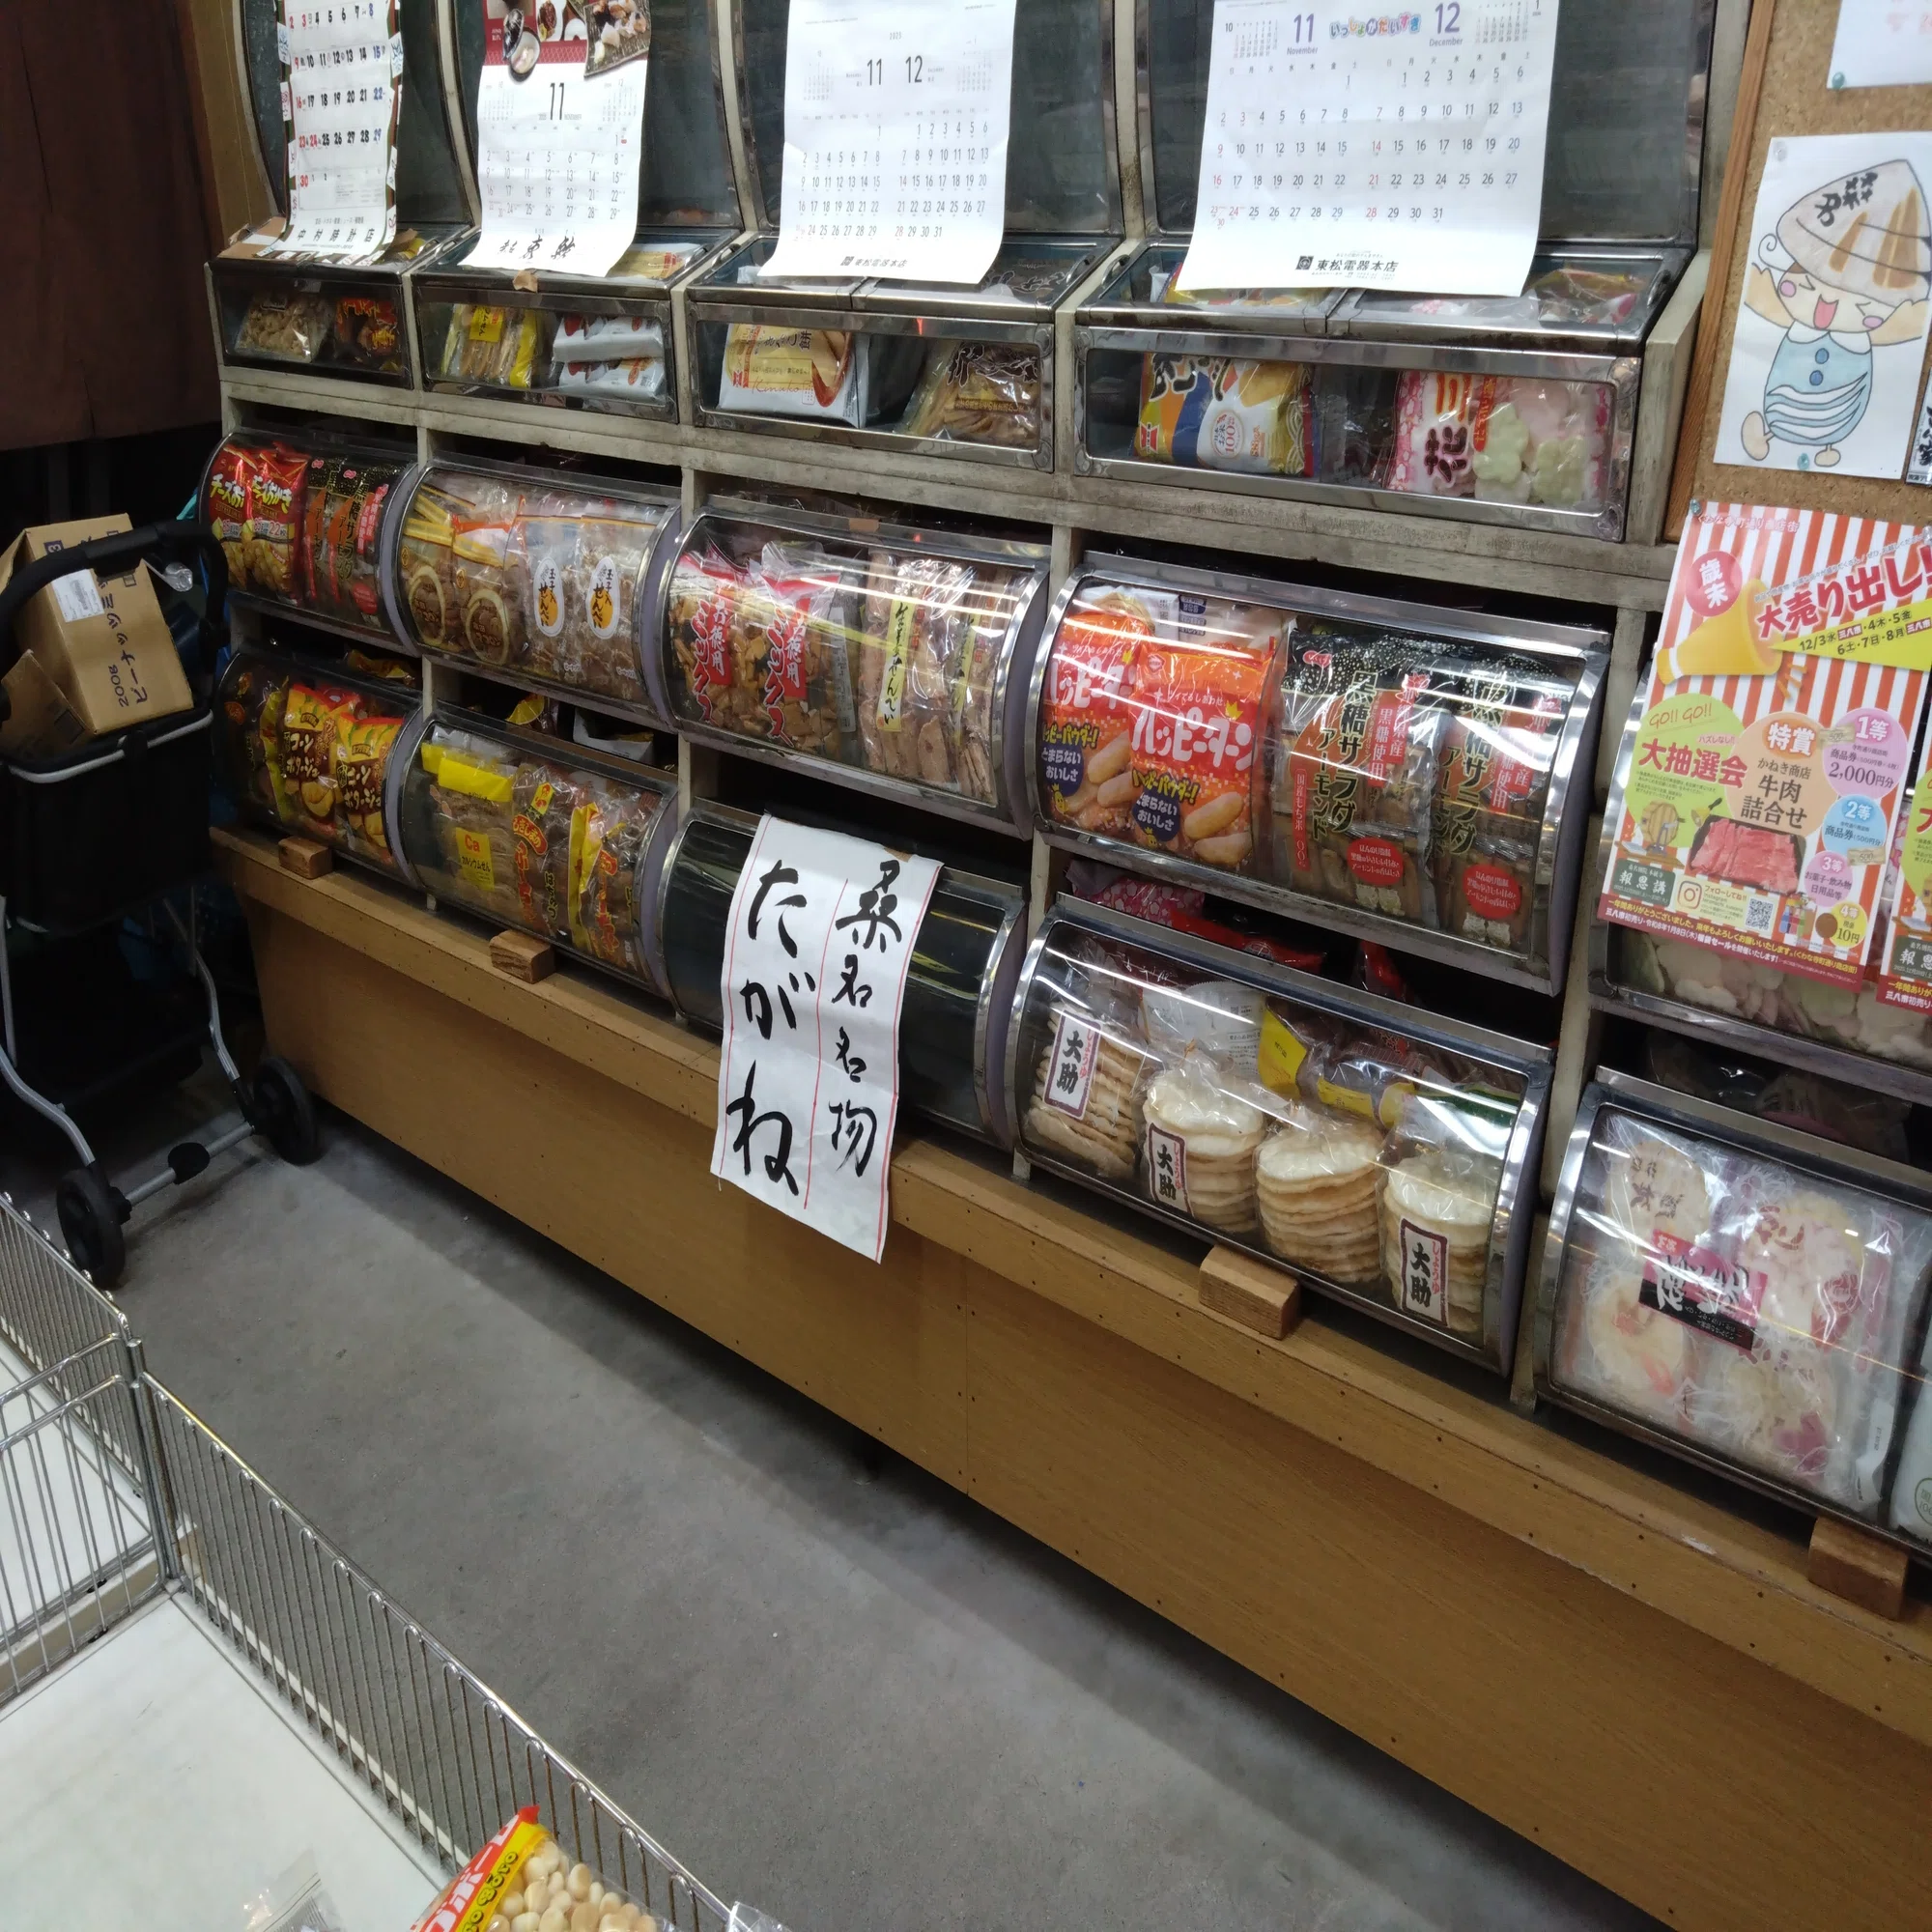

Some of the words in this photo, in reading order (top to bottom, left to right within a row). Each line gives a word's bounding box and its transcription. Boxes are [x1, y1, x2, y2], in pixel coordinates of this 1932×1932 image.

[327, 11, 333, 22] 5
[341, 8, 347, 20] 6
[1435, 3, 1461, 35] 12
[1293, 14, 1315, 43] 11
[1429, 37, 1463, 48] December
[1287, 45, 1318, 56] November
[307, 55, 314, 68] 10
[346, 49, 353, 62] 13
[867, 58, 882, 86] 11
[905, 55, 923, 84] 12
[1403, 72, 1407, 82] 1
[1446, 70, 1453, 81] 3
[1493, 68, 1500, 78] 5
[321, 94, 327, 106] 18
[347, 91, 355, 103] 20
[550, 82, 565, 121] 11
[1220, 113, 1227, 123] 2
[1259, 111, 1264, 121] 4
[1299, 110, 1306, 120] 6
[1342, 108, 1349, 119] 8
[1420, 105, 1428, 116] 9
[1465, 103, 1473, 115] 11
[322, 133, 329, 146] 25
[1417, 140, 1426, 151] 16
[1463, 139, 1472, 150] 18
[1508, 138, 1520, 149] 20
[941, 149, 948, 160] 10
[1237, 144, 1245, 154] 10
[1276, 143, 1284, 153] 12
[1296, 142, 1304, 153] 13
[1338, 141, 1347, 152] 15
[1373, 141, 1380, 151] 14
[300, 175, 308, 187] 30
[567, 170, 573, 182] 13
[939, 175, 947, 186] 17
[1234, 176, 1242, 185] 17
[1274, 175, 1282, 185] 19
[1314, 175, 1322, 185] 21
[1335, 175, 1345, 185] 22
[1413, 174, 1424, 185] 23
[1435, 174, 1446, 185] 24
[1482, 173, 1493, 185] 26
[1505, 173, 1518, 185] 27
[567, 187, 573, 199] 20
[567, 206, 573, 217] 27
[923, 201, 931, 213] 23
[1249, 207, 1259, 216] 25
[1311, 207, 1321, 217] 28
[1388, 208, 1399, 217] 29
[1410, 208, 1421, 218] 30
[1433, 208, 1442, 218] 31
[934, 226, 942, 237] 31
[1317, 259, 1399, 272] 東松電器本店
[1698, 556, 1729, 609] 歳末
[1649, 709, 1679, 728] GO!!
[1682, 702, 1712, 724] GO!!
[1856, 716, 1889, 741] 1等
[1131, 706, 1253, 771] ハッピーターン
[1368, 708, 1394, 783] 黒糖使用
[1767, 722, 1815, 756] 特賞
[1041, 748, 1081, 765] とまらない
[1330, 670, 1378, 834] 黒糖サラダ
[1638, 738, 1747, 789] 大抽選会
[1757, 758, 1812, 780] かねき商店
[1045, 765, 1079, 782] おいしさ
[1829, 762, 1894, 789] 2,000円分
[1312, 727, 1336, 840] アーモンド
[1758, 775, 1802, 804] 牛肉
[1741, 795, 1807, 830] 詰合せ
[1845, 801, 1873, 821] 2等
[1137, 810, 1176, 832] おいしさ
[465, 834, 480, 853] Ca
[1822, 857, 1843, 872] 3等
[1810, 884, 1842, 900] 日用品等
[1836, 928, 1861, 944] 10円
[829, 859, 902, 1179] 桑名名物
[725, 859, 816, 1197] たがね
[1056, 1030, 1085, 1095] 大助
[1156, 1144, 1179, 1201] 大助
[1409, 1242, 1432, 1309] 大助
